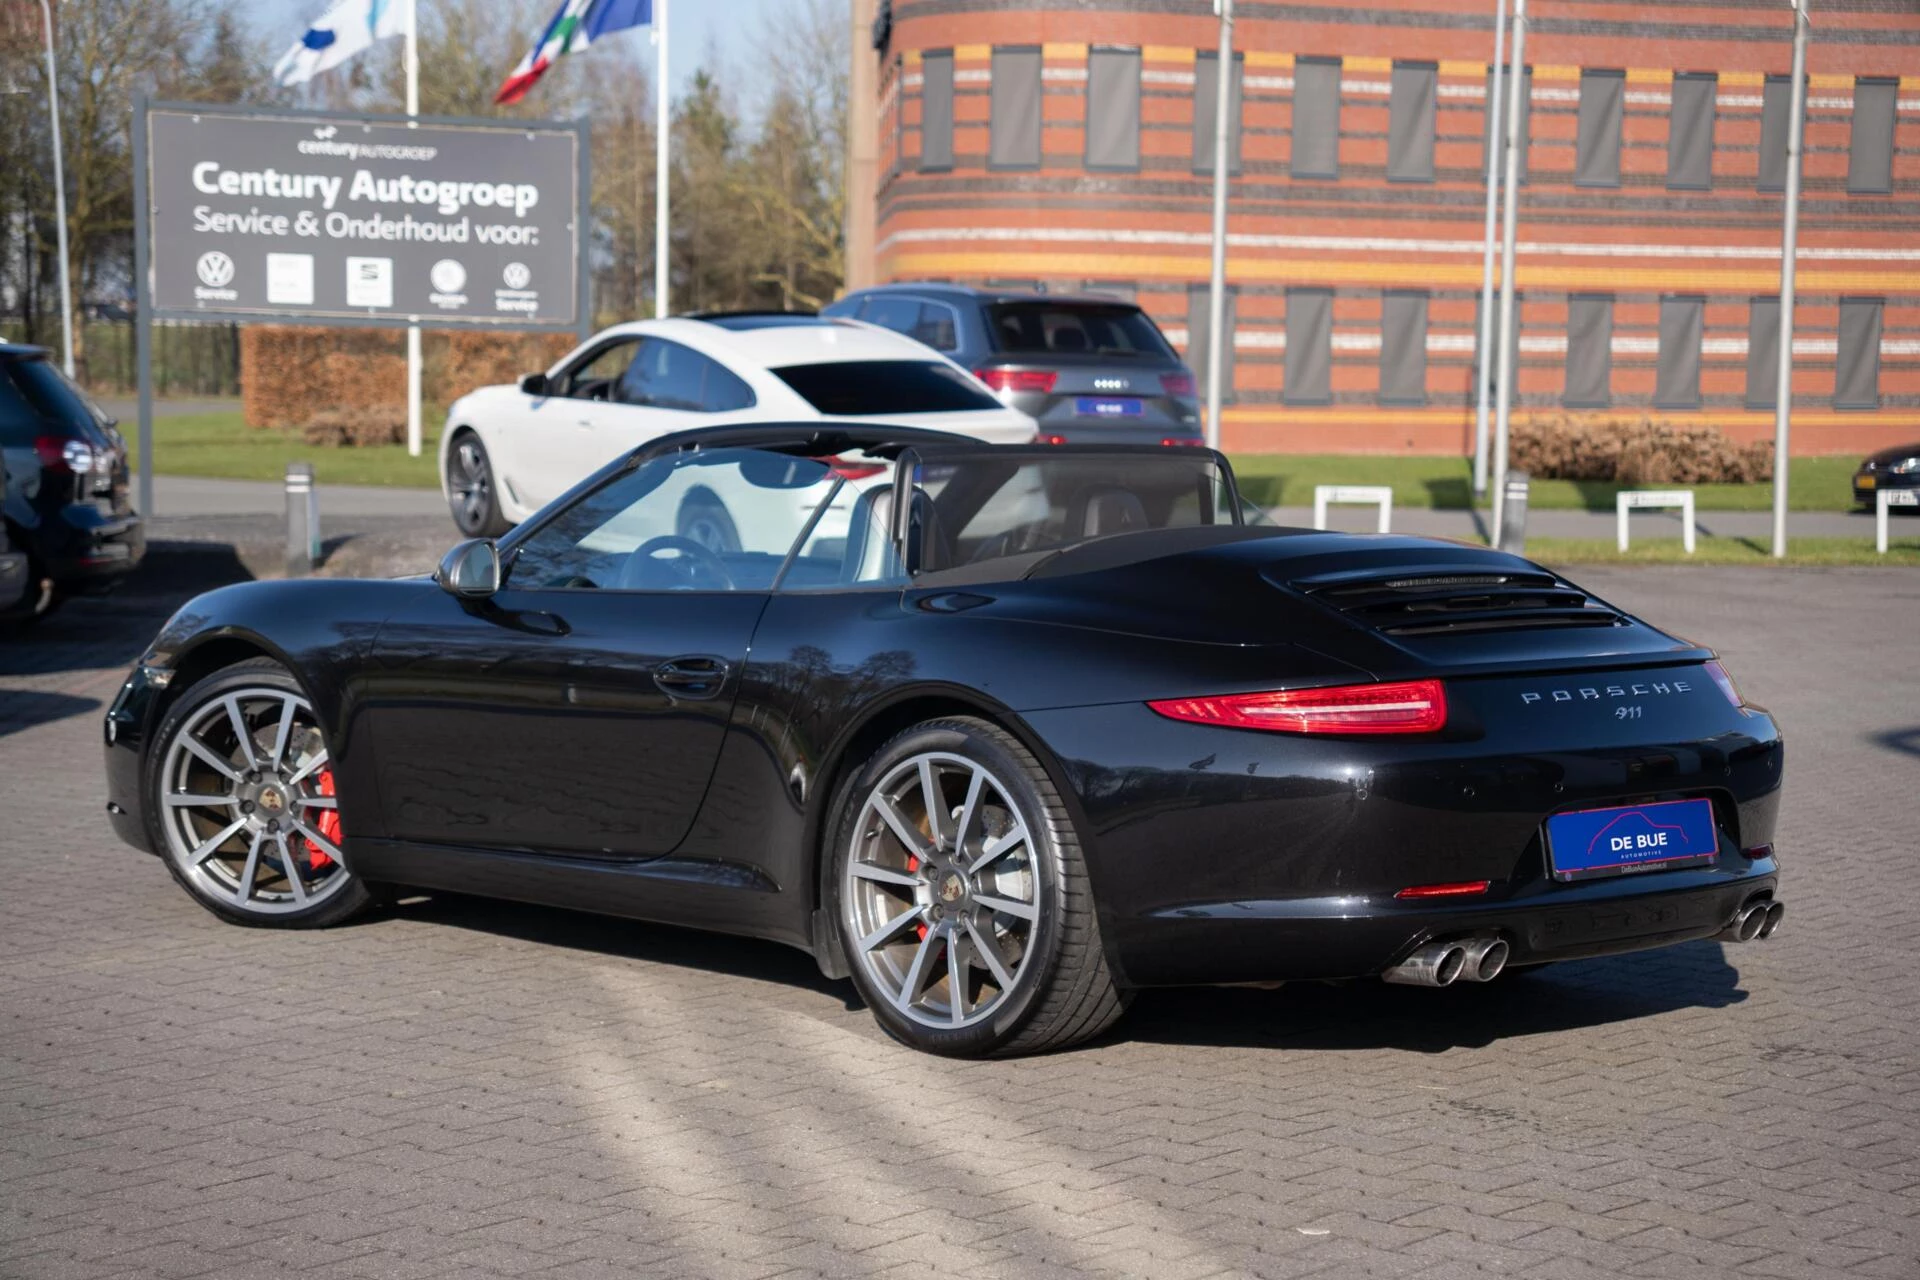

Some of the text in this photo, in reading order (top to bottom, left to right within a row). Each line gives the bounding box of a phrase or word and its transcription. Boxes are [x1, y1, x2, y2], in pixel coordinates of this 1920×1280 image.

[193, 161, 539, 218] Century Autogroep
[193, 205, 540, 246] Service & Onderhoud voor:
[1521, 681, 1692, 704] PORSCHE
[1615, 706, 1642, 719] 911
[1610, 832, 1668, 851] DE BUE
[1620, 850, 1662, 859] AUTOMOTIVE
